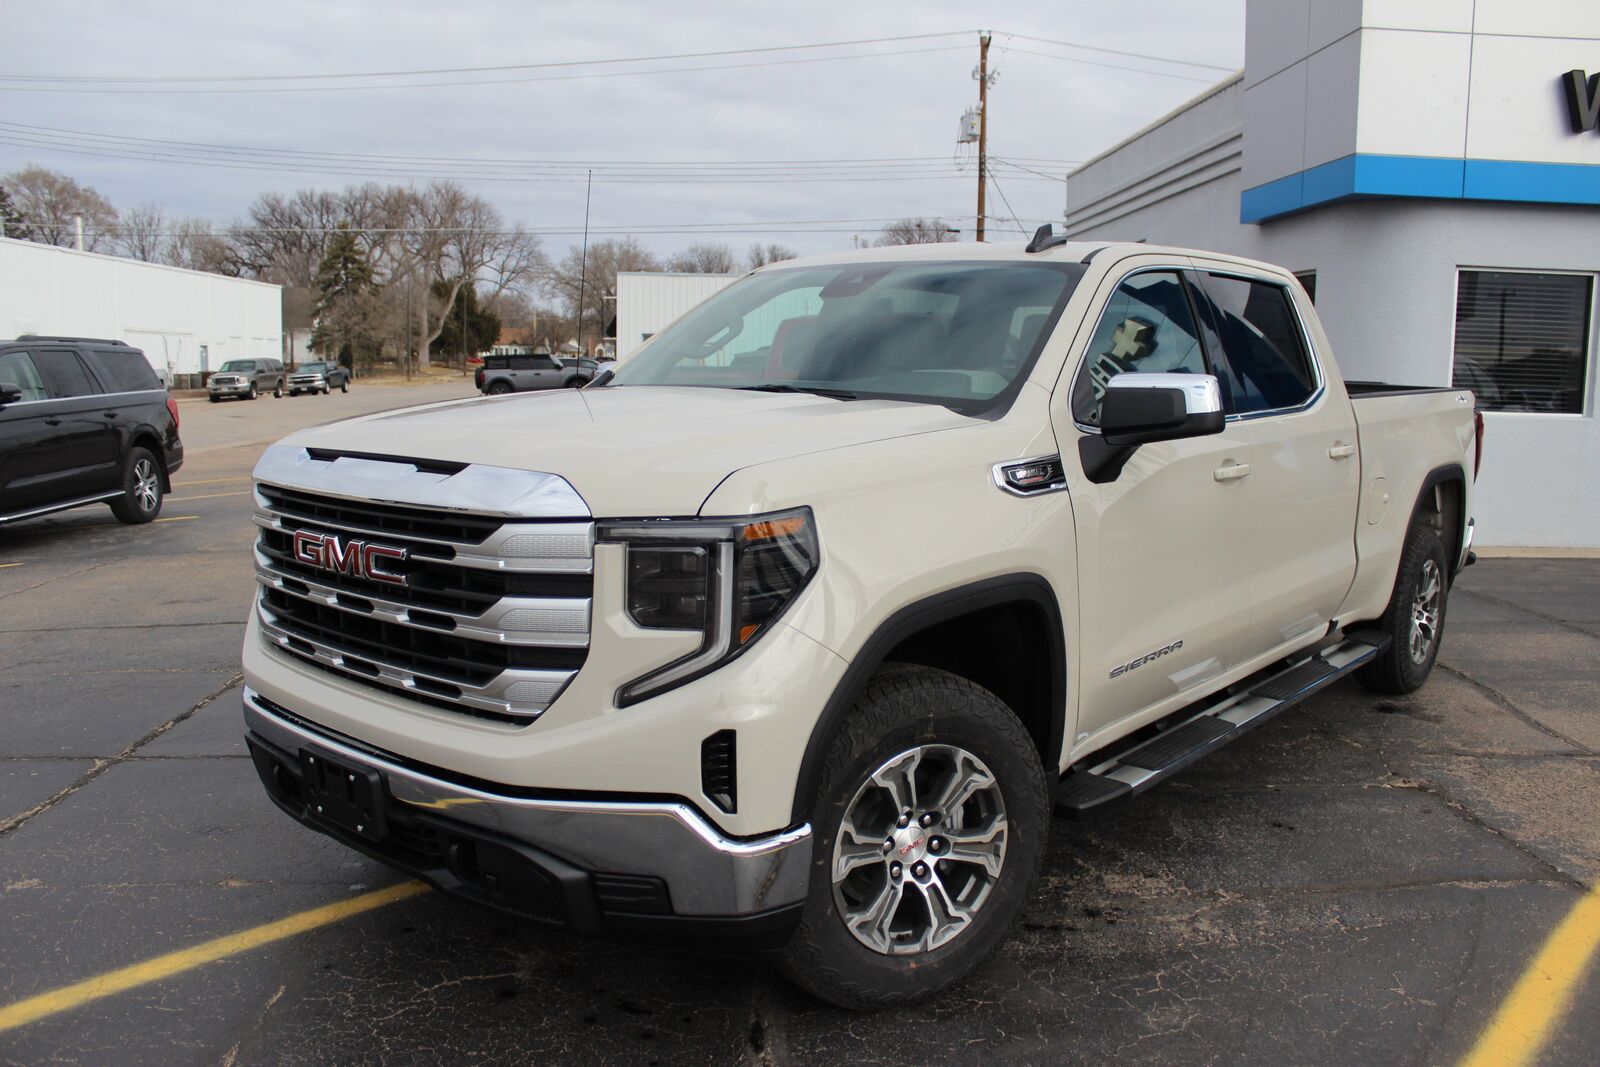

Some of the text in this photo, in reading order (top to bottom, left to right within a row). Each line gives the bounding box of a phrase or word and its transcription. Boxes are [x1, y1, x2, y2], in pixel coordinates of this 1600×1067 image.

[293, 529, 408, 587] GMC
[1109, 640, 1183, 679] SIERRA
[900, 835, 925, 855] GMC
